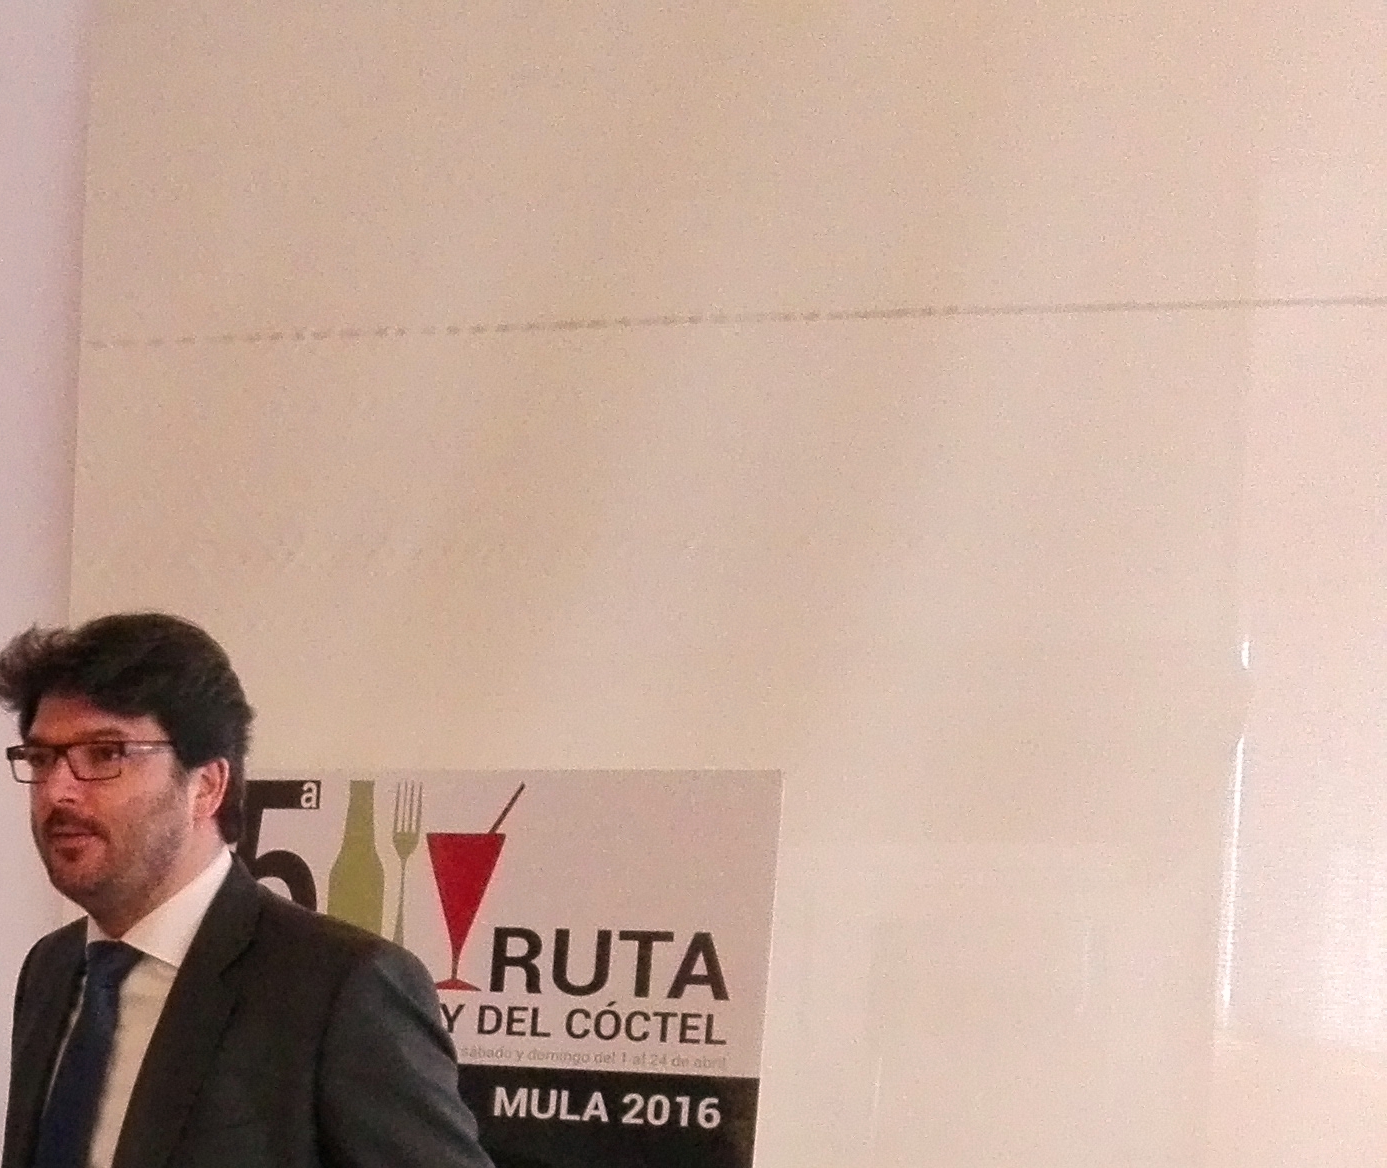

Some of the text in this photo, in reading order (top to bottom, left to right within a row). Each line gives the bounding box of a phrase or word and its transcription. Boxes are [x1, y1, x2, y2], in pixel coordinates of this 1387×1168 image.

[489, 926, 731, 1002] RUTA
[440, 1001, 727, 1046] Y DEL CÓCTEL
[493, 1086, 722, 1130] MULA 2016
